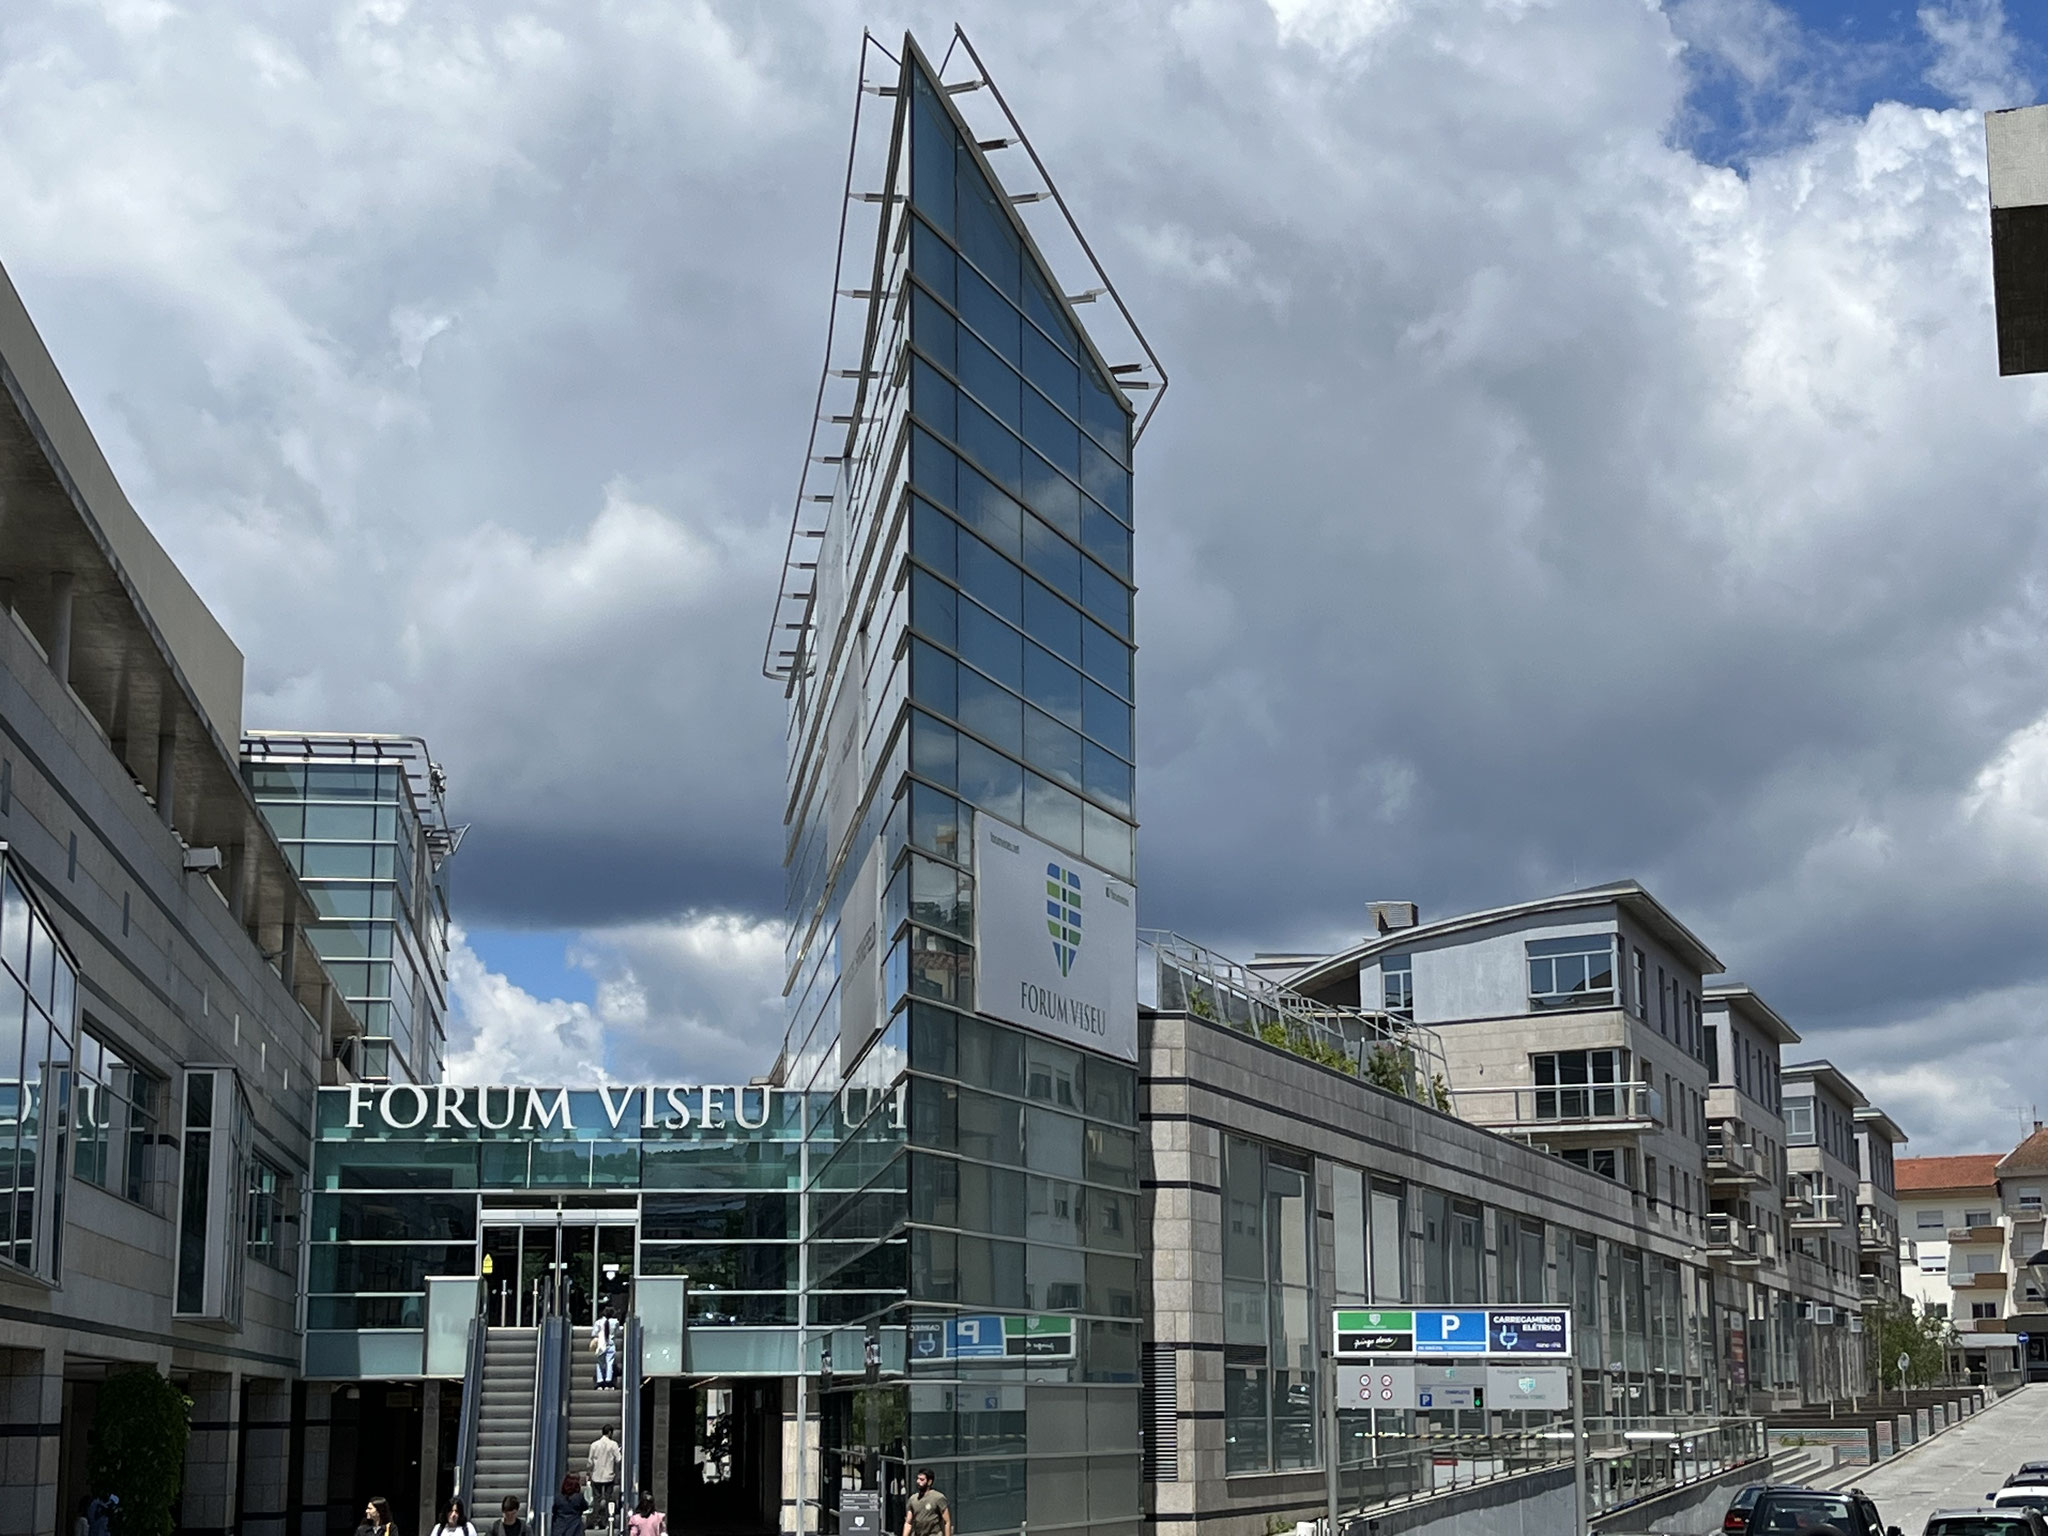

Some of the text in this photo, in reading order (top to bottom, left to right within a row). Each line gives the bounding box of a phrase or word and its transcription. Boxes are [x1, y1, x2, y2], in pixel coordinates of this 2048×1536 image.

[1021, 981, 1105, 1037] FORUM VISEU
[345, 1082, 774, 1130] FORUM VISEU
[1441, 1314, 1460, 1340] P
[1493, 1315, 1561, 1323] CARREGAMENTO
[1522, 1323, 1561, 1332] ELÉTRICO
[1422, 1395, 1430, 1405] P
